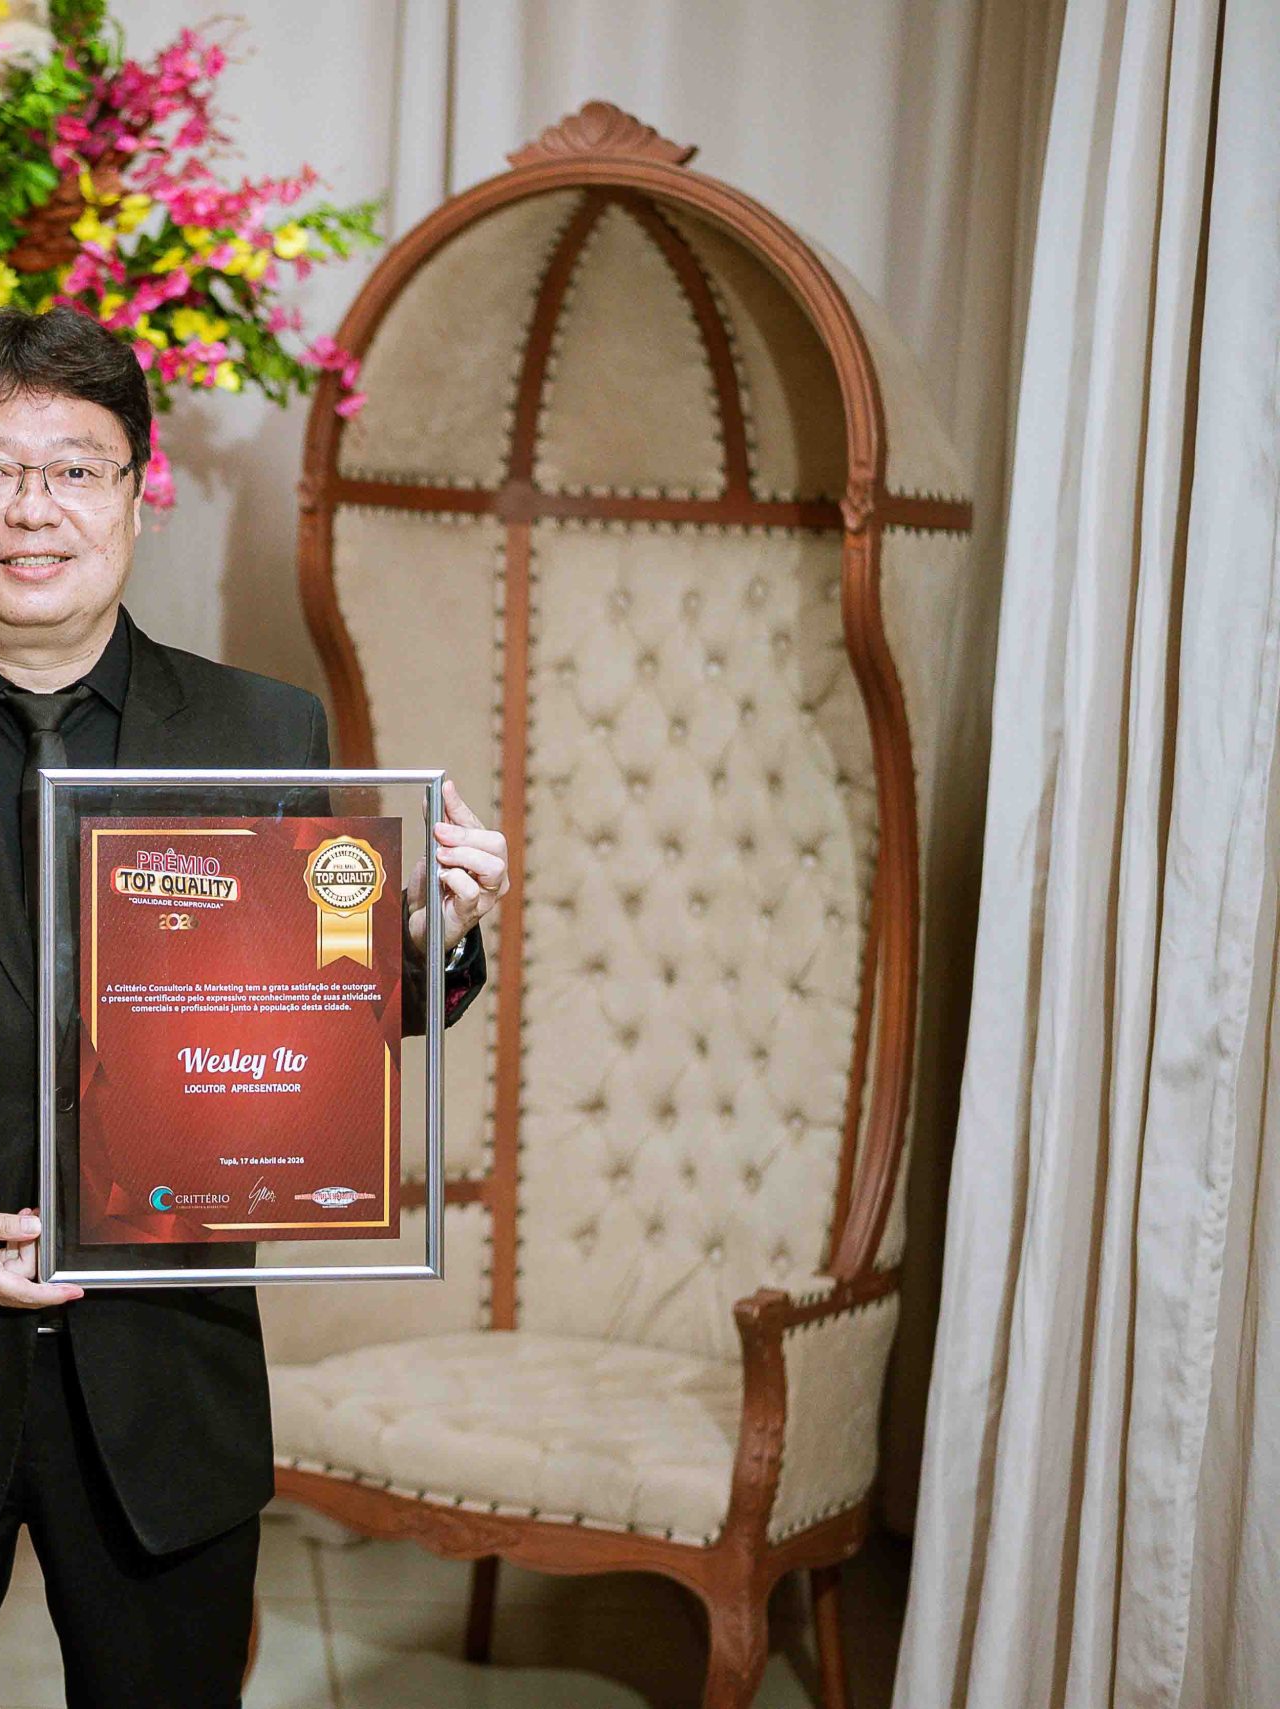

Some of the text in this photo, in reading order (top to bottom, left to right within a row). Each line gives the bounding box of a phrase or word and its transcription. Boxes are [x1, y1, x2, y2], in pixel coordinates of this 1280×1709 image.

[137, 848, 220, 876] PRÊMIO
[316, 872, 373, 884] TOP QUALITY
[120, 871, 234, 898] TOP QUALITY
[106, 984, 113, 992] A
[115, 984, 147, 992] Crittério
[148, 984, 193, 992] Consultoria
[195, 984, 202, 992] &
[204, 984, 243, 994] Marketing
[269, 984, 289, 992] grata
[291, 983, 329, 992] satisfação
[331, 983, 340, 991] de
[342, 984, 376, 992] outorgar
[109, 995, 142, 1004] presente
[144, 994, 186, 1002] certificado
[187, 994, 205, 1003] pelo
[206, 994, 247, 1003] expressivo
[249, 993, 309, 1001] reconhecimento
[311, 993, 321, 1001] de
[131, 1004, 172, 1012] comerciais
[180, 1003, 229, 1013] profissionais
[231, 1003, 252, 1013] junto
[253, 1003, 259, 1011] à
[260, 1003, 299, 1013] população
[301, 1003, 322, 1011] desta
[324, 1002, 352, 1011] cidade.
[177, 1046, 308, 1080] Wesley Ito
[184, 1083, 301, 1093] LOCUTOR APRESENTADOR
[175, 1193, 230, 1204] CRITTÉRIO
